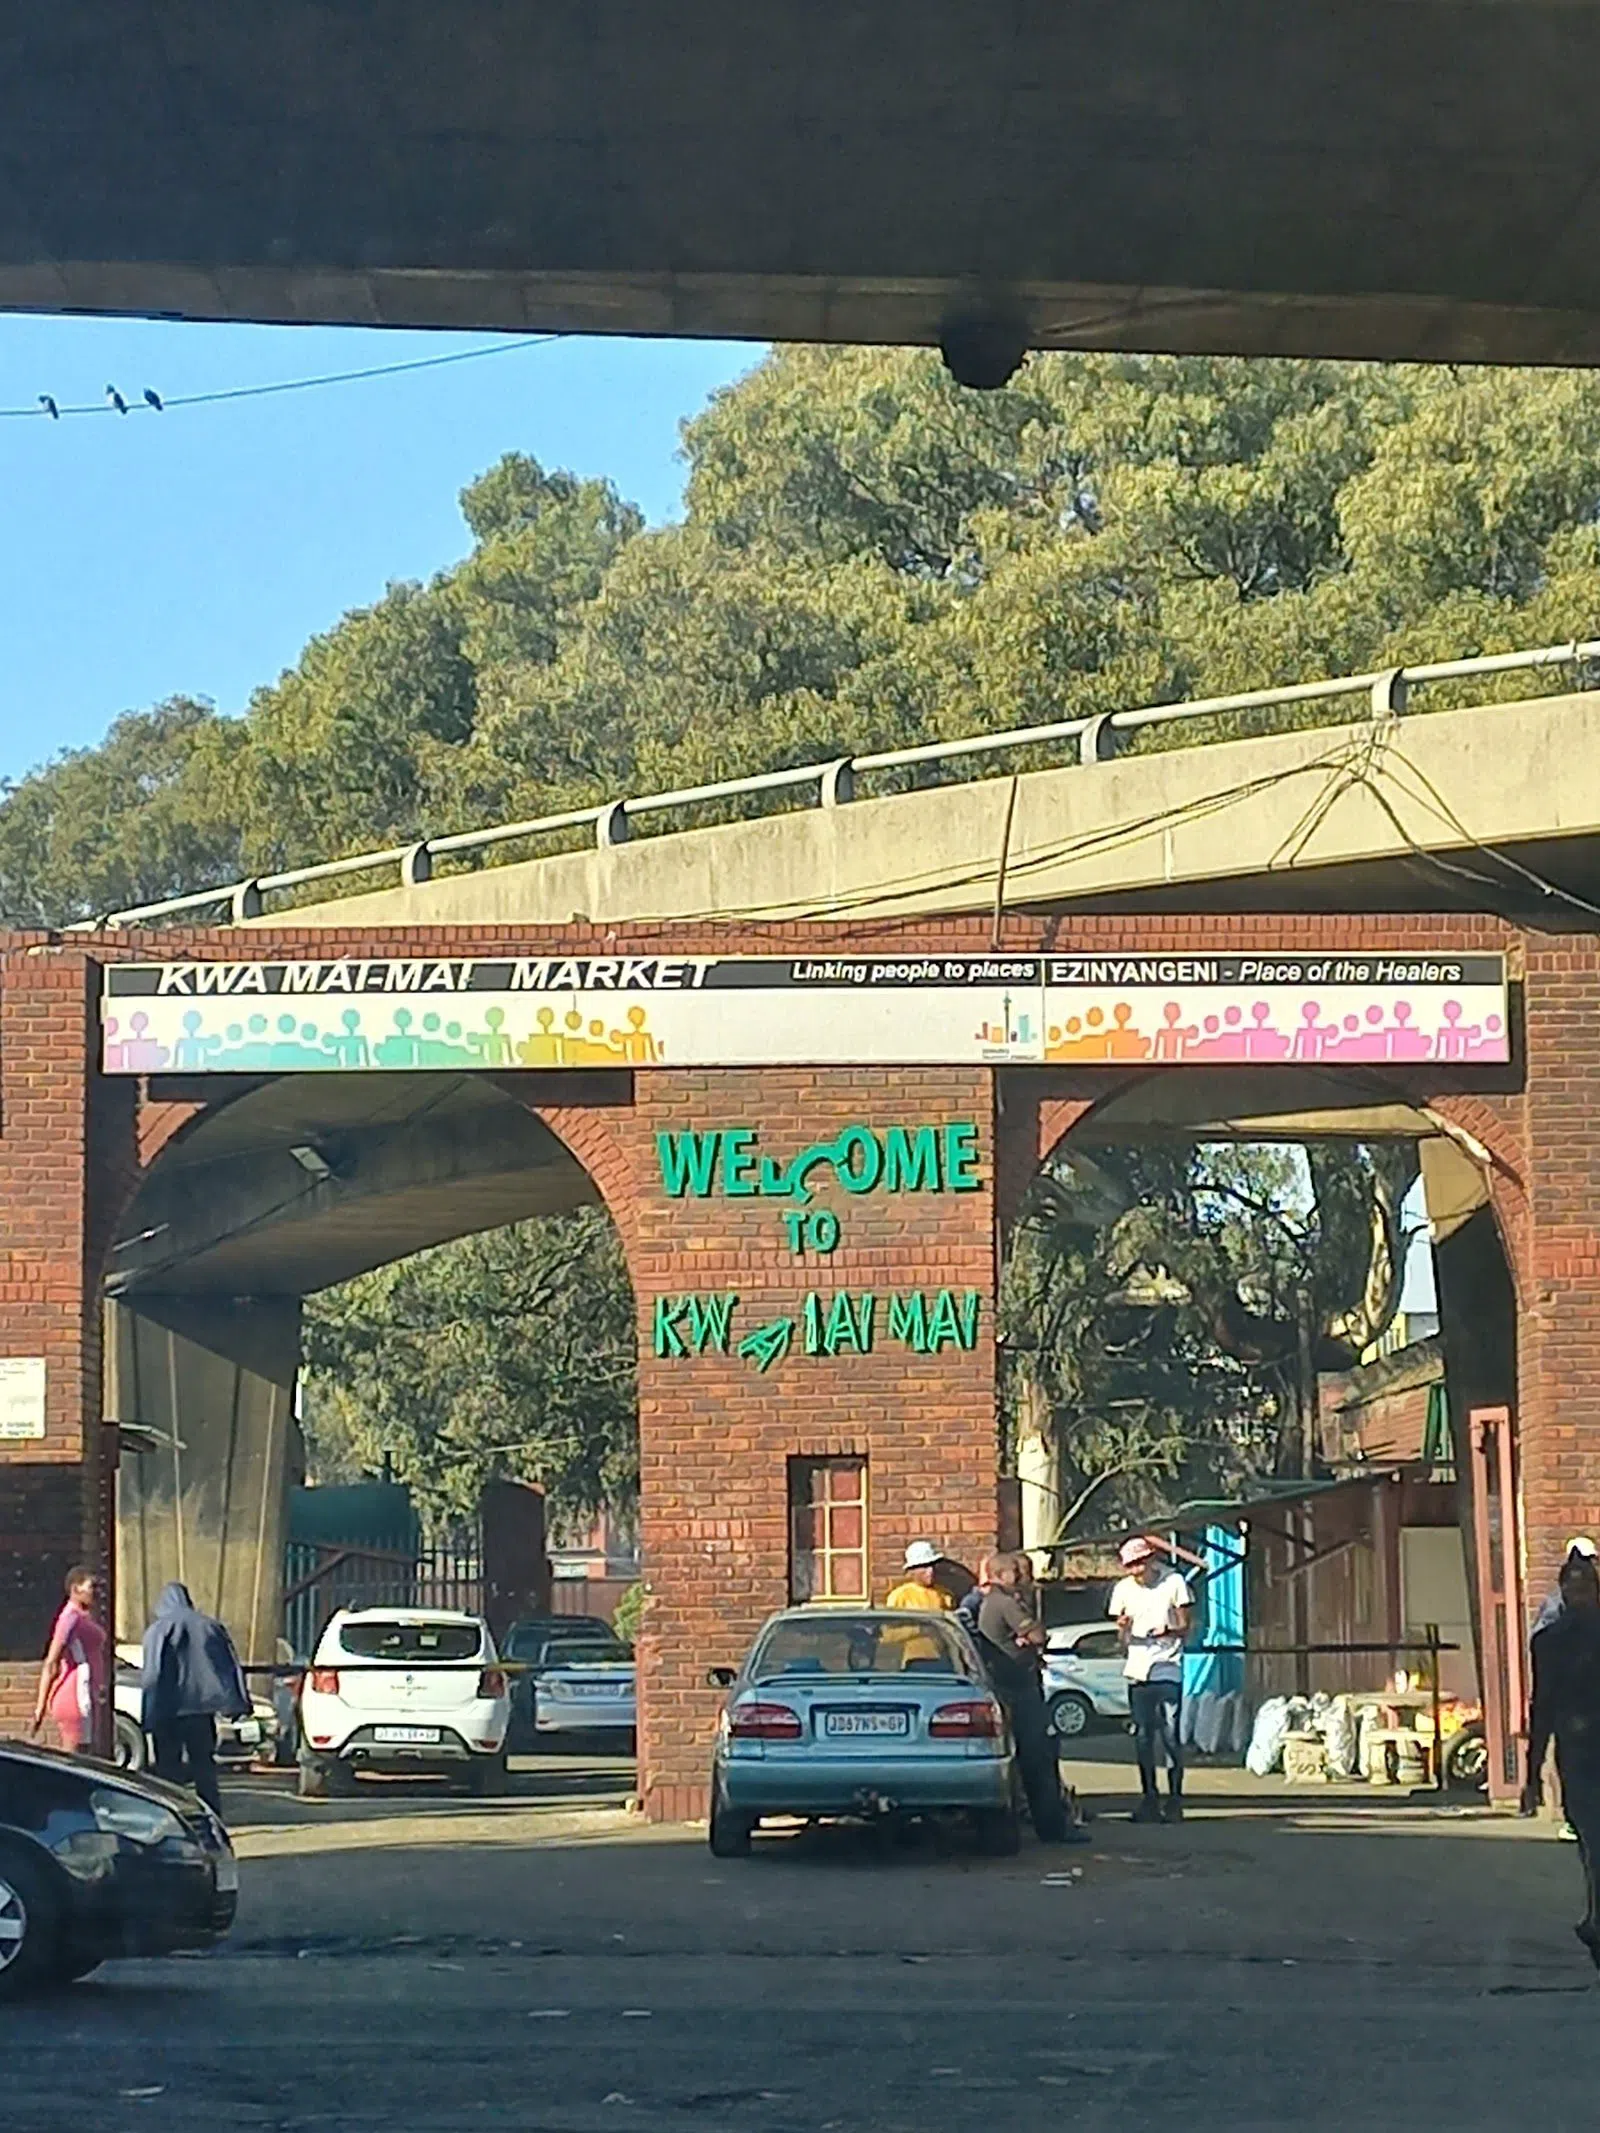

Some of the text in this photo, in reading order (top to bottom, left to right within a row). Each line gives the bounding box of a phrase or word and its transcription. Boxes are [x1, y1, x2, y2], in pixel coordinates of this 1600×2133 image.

[157, 963, 268, 995] KWA
[509, 959, 718, 990] MARKET
[792, 960, 1035, 983] Linking people to places
[1051, 961, 1218, 983] EZINYANGENI
[1239, 961, 1301, 982] Place
[1307, 961, 1333, 981] of
[1334, 961, 1370, 981] the
[1375, 961, 1462, 981] Healers
[656, 1121, 983, 1204] WELCOME
[783, 1208, 840, 1253] TO
[888, 1289, 980, 1355] MAI
